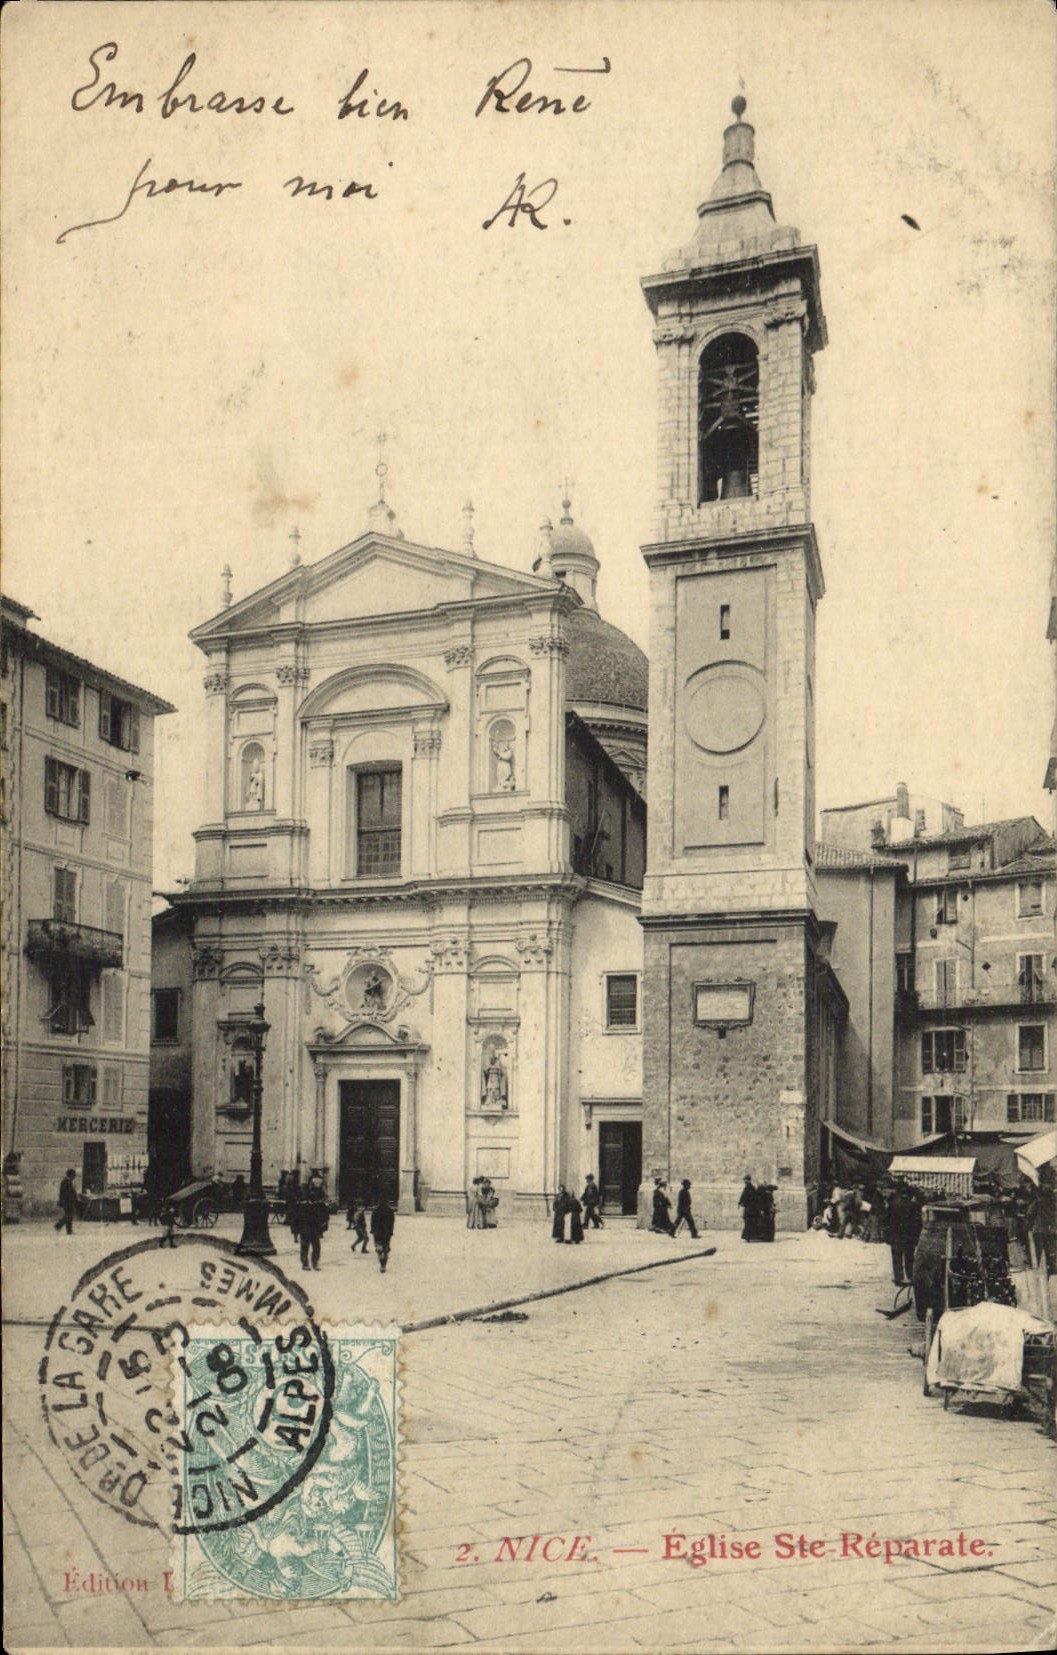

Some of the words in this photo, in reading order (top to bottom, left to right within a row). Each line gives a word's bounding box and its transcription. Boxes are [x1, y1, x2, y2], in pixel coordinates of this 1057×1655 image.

[337, 68, 410, 121] bien
[56, 157, 242, 244] pour
[283, 160, 394, 200] moi
[57, 1117, 134, 1135] MERCERIE
